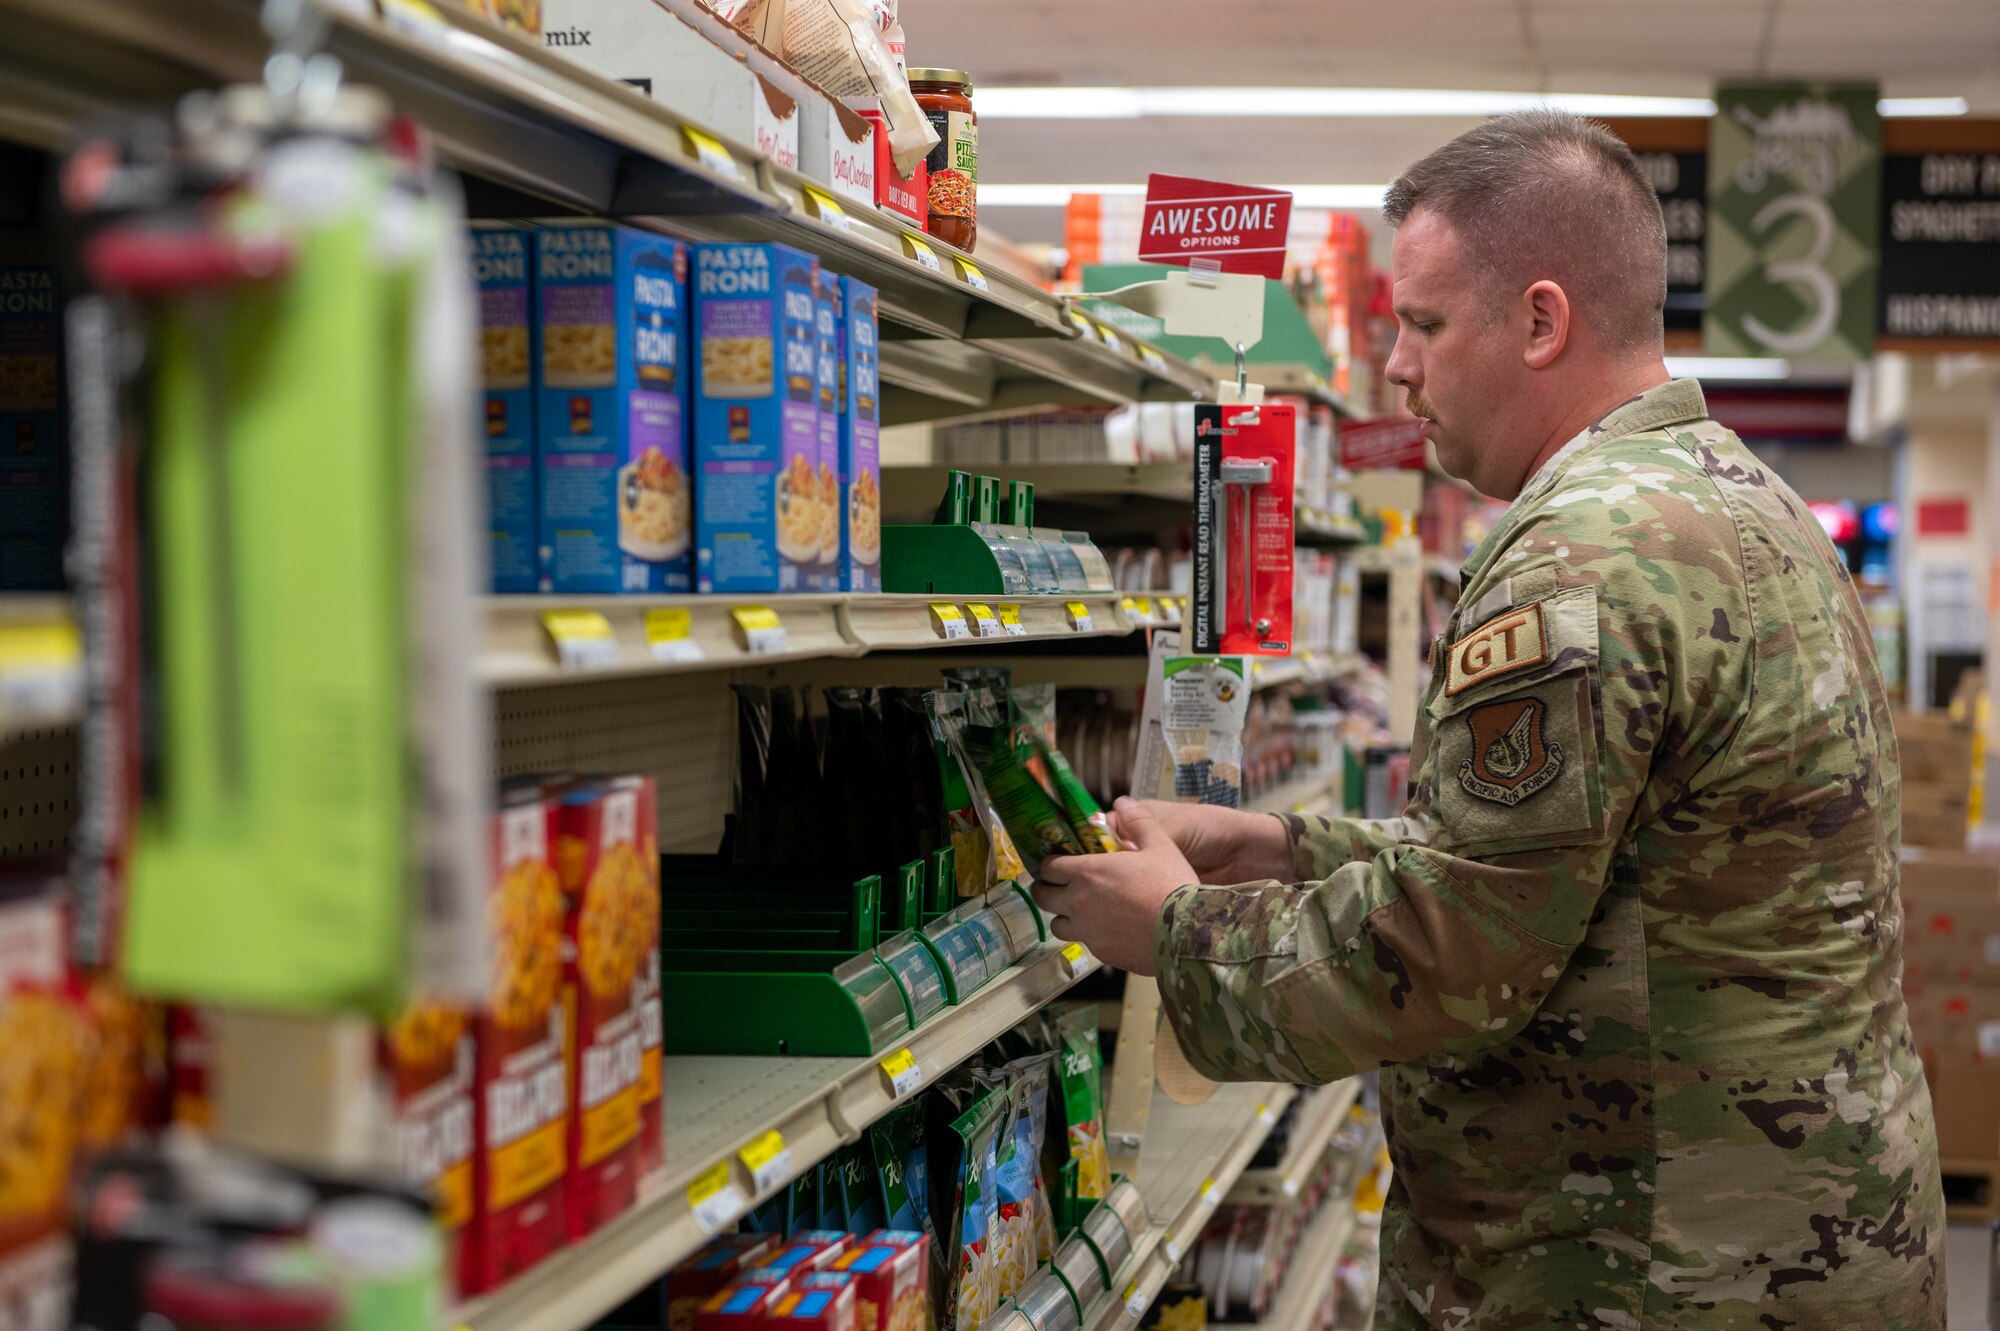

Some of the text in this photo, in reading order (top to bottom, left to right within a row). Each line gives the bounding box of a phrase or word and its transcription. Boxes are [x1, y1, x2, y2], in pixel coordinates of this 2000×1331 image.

[546, 26, 591, 46] mix
[834, 150, 872, 191] Betty Crocker
[888, 185, 918, 213] BOB'S RED MILL
[1150, 203, 1277, 236] AWESOME
[541, 230, 612, 252] PASTA
[1180, 235, 1241, 248] OPTIONS
[475, 257, 525, 281] ONI
[540, 253, 613, 278] RONI
[698, 247, 769, 269] PASTA
[0, 271, 53, 289] ASTA
[699, 269, 770, 294] RONI
[1741, 194, 1839, 352] 3
[634, 274, 676, 310] PASTA
[785, 290, 814, 321] PASTA
[635, 328, 677, 365] RONI
[1196, 443, 1211, 649] DIGITAL INSTANT READ THERMOMETER
[1460, 617, 1527, 676] GT
[1464, 761, 1557, 803] PACIFIC AIR FORCES
